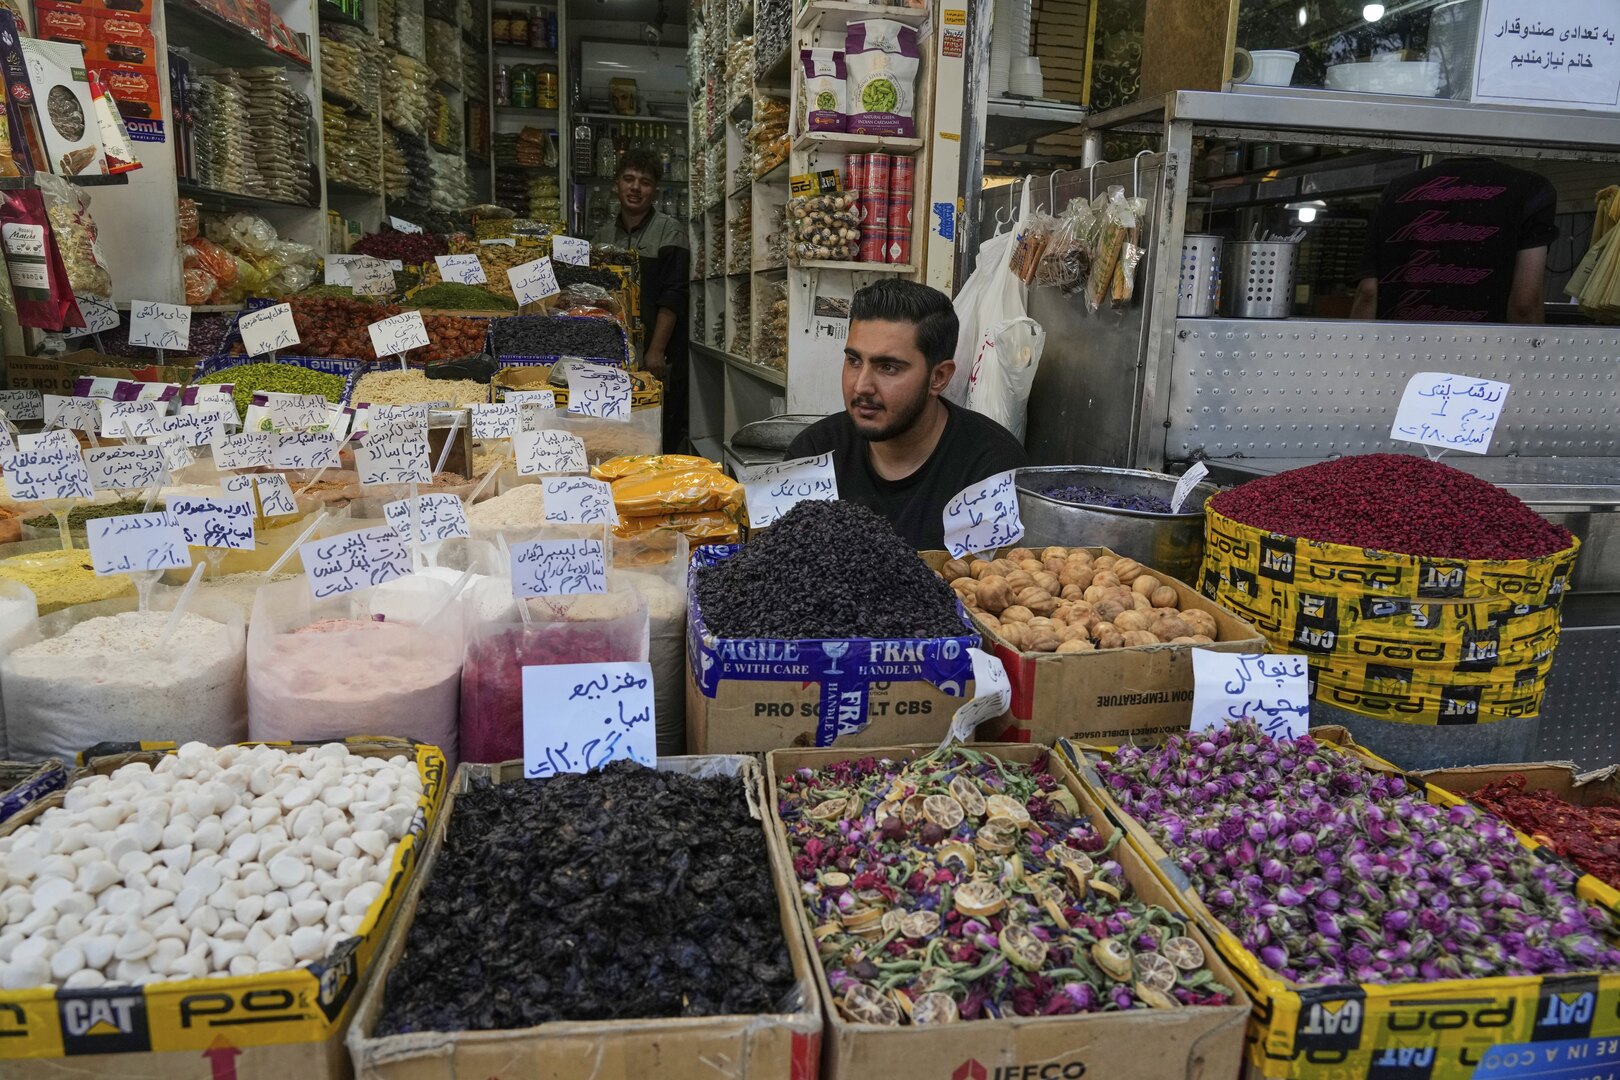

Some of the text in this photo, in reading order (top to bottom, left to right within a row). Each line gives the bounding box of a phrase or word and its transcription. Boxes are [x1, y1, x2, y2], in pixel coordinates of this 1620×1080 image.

[1495, 18, 1615, 46] به تعدادی صندوقدار
[1511, 50, 1593, 73] خانم نیازمندیم
[1262, 547, 1293, 574] CAT
[1424, 567, 1463, 588] CAT
[1300, 626, 1335, 650] CAT
[1466, 640, 1498, 661] CAT
[735, 664, 771, 675] WITH
[773, 665, 810, 676] CARE
[859, 665, 915, 676] HANDLE
[754, 703, 795, 717] PRO
[895, 700, 933, 715] CBS
[1096, 690, 1171, 708] TEMPERATURE
[1445, 699, 1476, 715] CAT
[1101, 728, 1131, 738] EDIBLE
[64, 998, 137, 1036] CAT
[1303, 998, 1361, 1035] CAT
[1540, 992, 1595, 1027] CAT
[1545, 1047, 1559, 1062] A
[1566, 1043, 1588, 1060] IN
